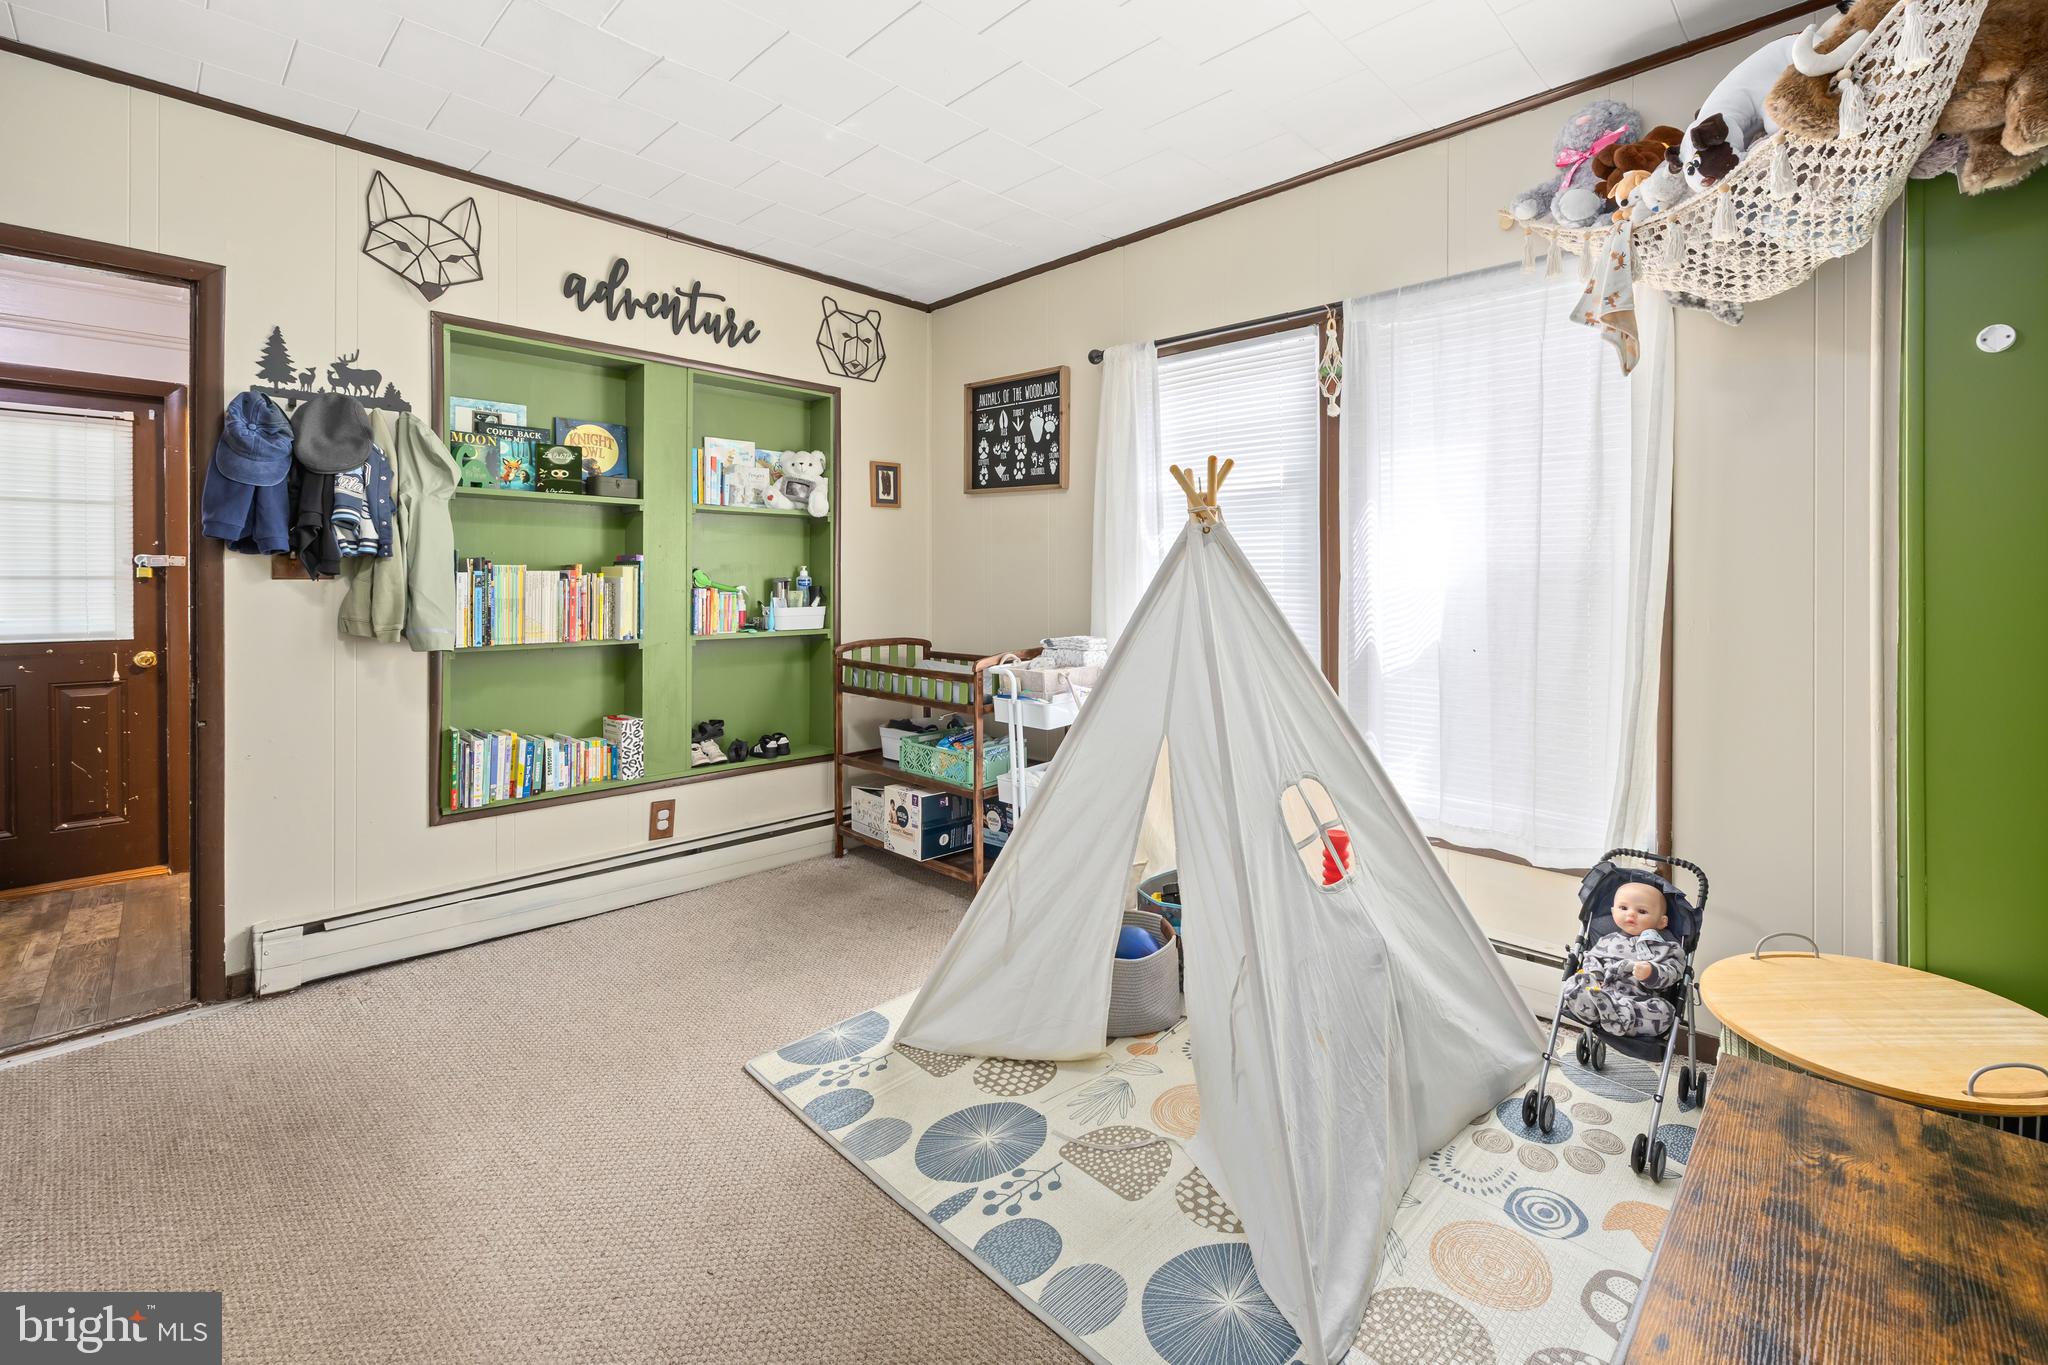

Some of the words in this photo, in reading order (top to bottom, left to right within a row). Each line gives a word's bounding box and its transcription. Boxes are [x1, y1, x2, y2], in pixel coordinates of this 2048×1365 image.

[563, 257, 761, 348] adventure
[978, 391, 1001, 408] ANIMALS
[1002, 389, 1010, 403] OF
[1013, 387, 1022, 402] THE
[1025, 380, 1058, 400] WOODLANDS
[450, 431, 497, 447] MOON
[486, 427, 514, 437] COME
[517, 431, 542, 440] BACK
[569, 431, 615, 450] KNIGHT
[582, 445, 606, 459] OWL
